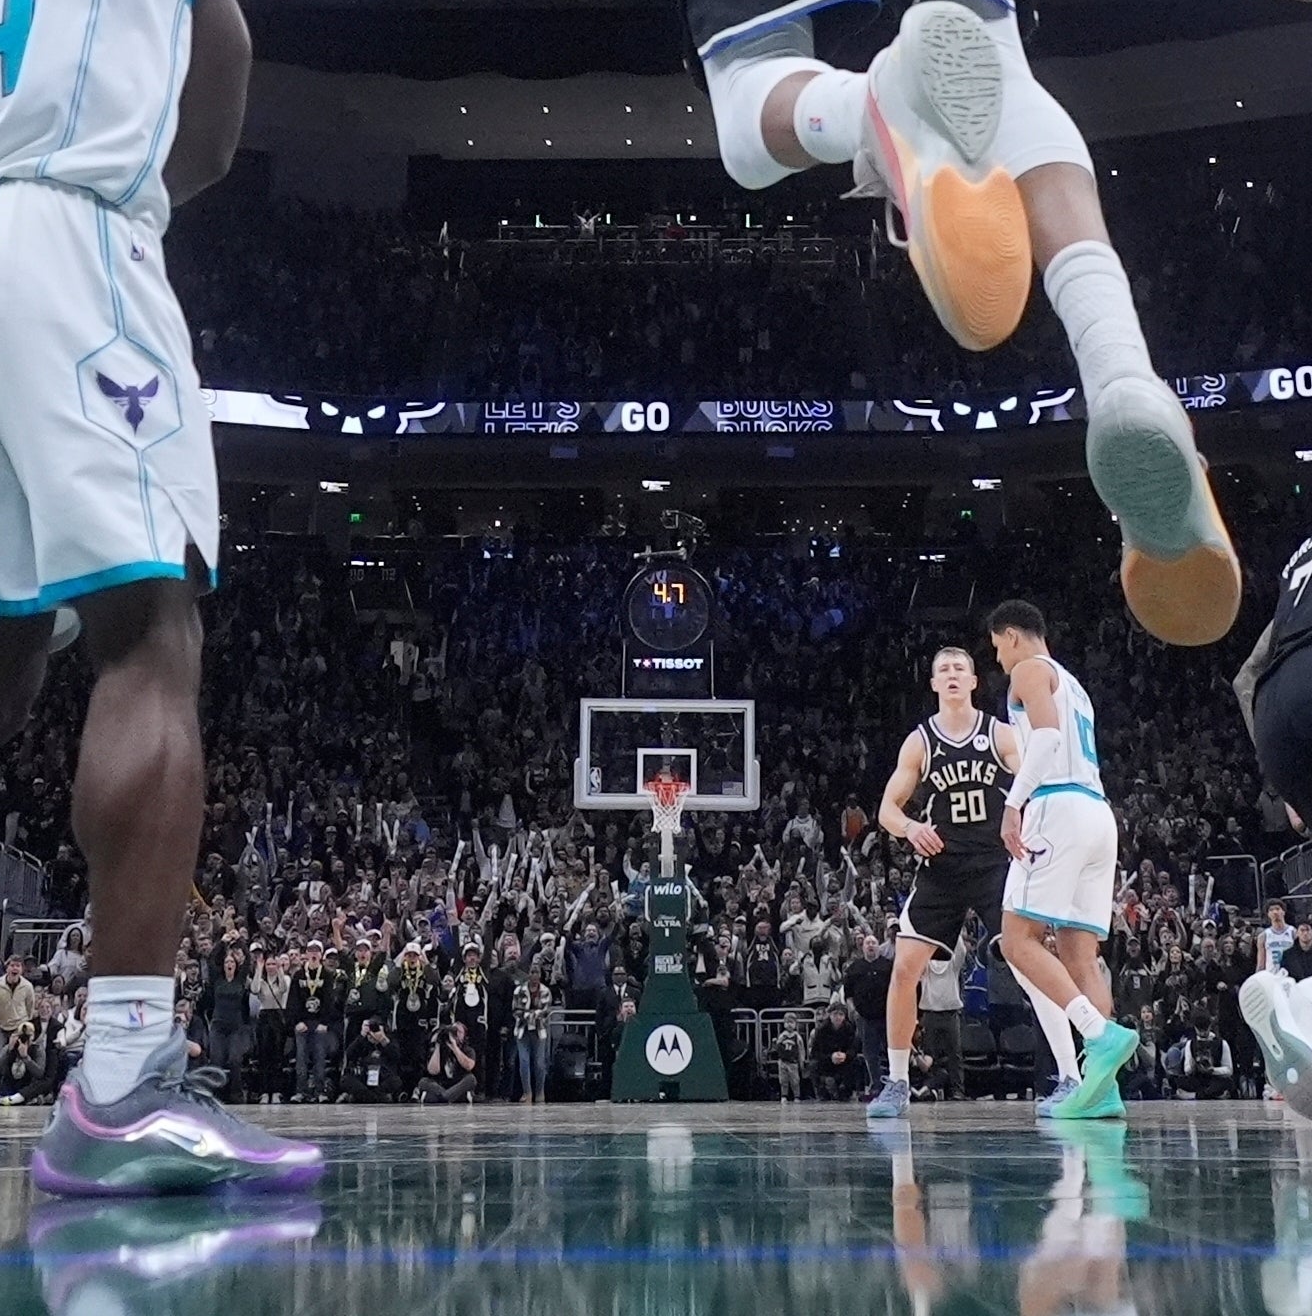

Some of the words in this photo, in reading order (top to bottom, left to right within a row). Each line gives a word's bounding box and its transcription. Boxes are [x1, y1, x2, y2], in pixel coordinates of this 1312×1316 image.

[621, 401, 670, 432] GO
[653, 582, 686, 604] 4.7
[651, 658, 705, 670] TISSOT
[929, 760, 998, 792] BUCKS
[950, 789, 987, 823] 20
[653, 882, 683, 896] wilo
[653, 919, 682, 928] ULTRA
